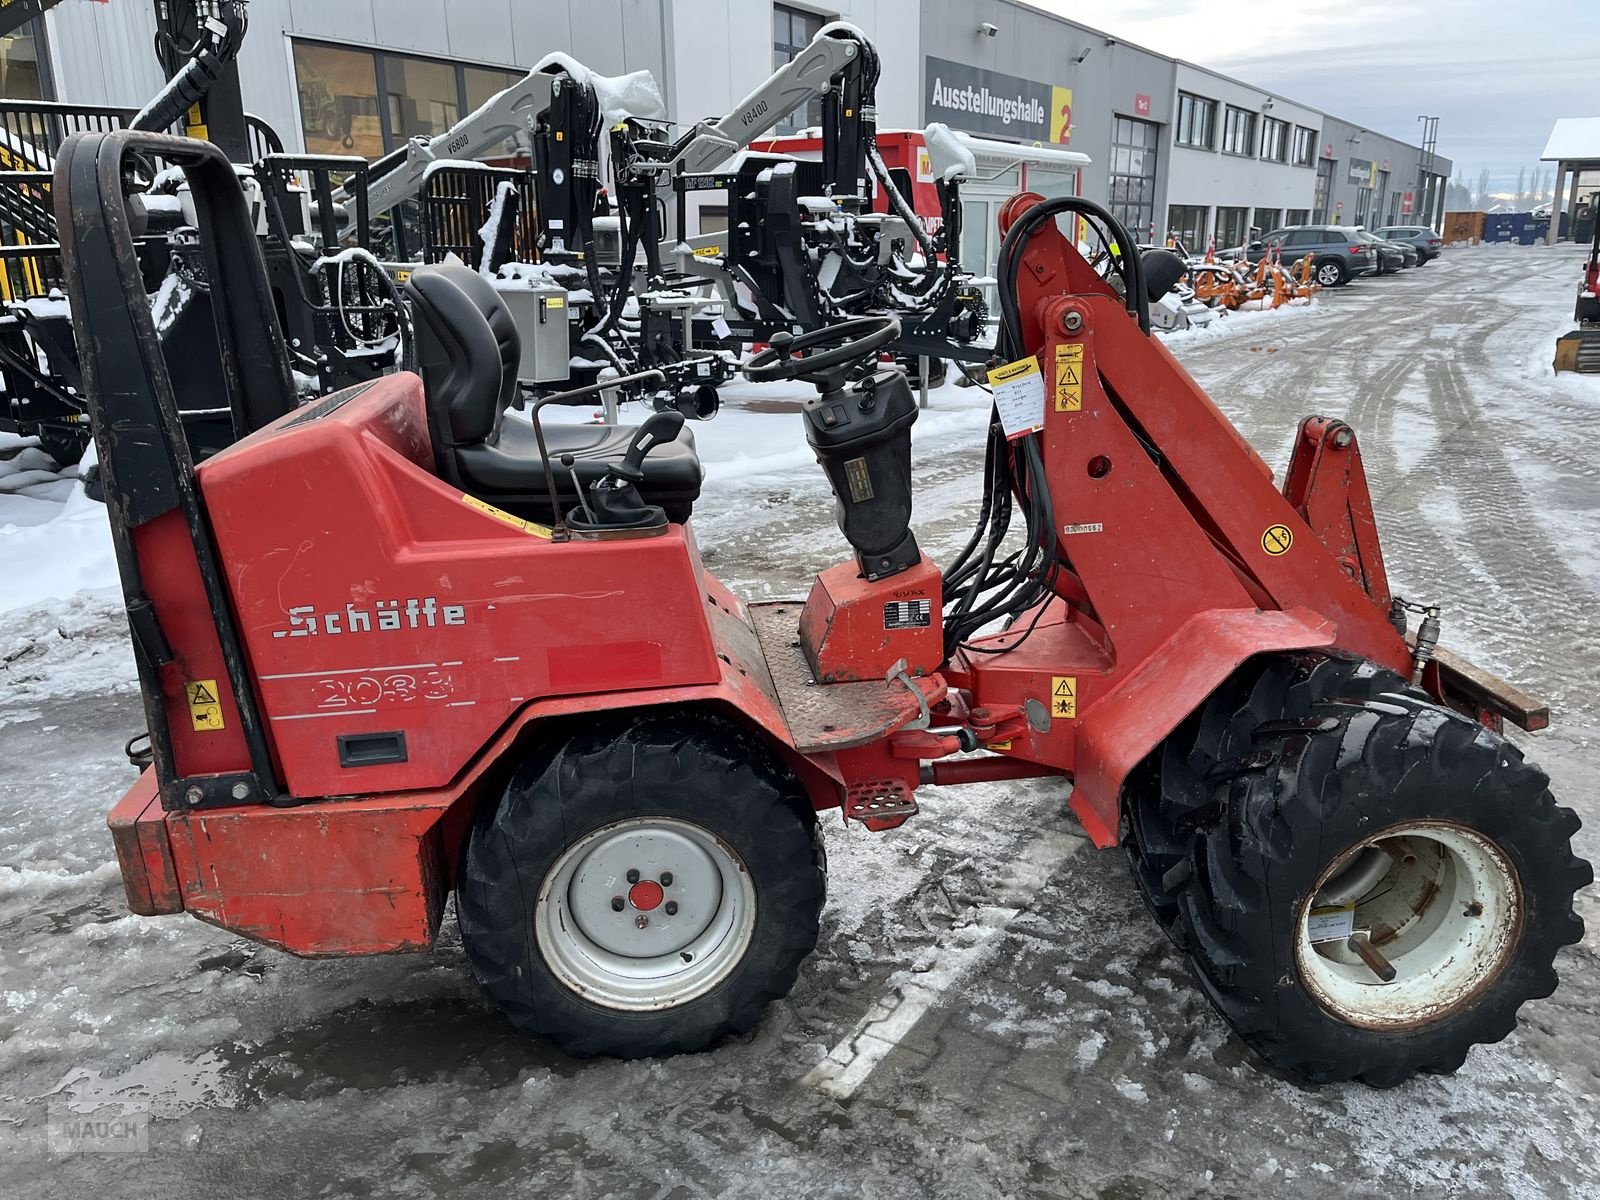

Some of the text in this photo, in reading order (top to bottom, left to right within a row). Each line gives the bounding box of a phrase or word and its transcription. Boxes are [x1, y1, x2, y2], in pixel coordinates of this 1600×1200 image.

[741, 100, 768, 126] V8400
[932, 77, 1071, 145] Ausstellungshalle 2
[447, 133, 469, 155] V6800
